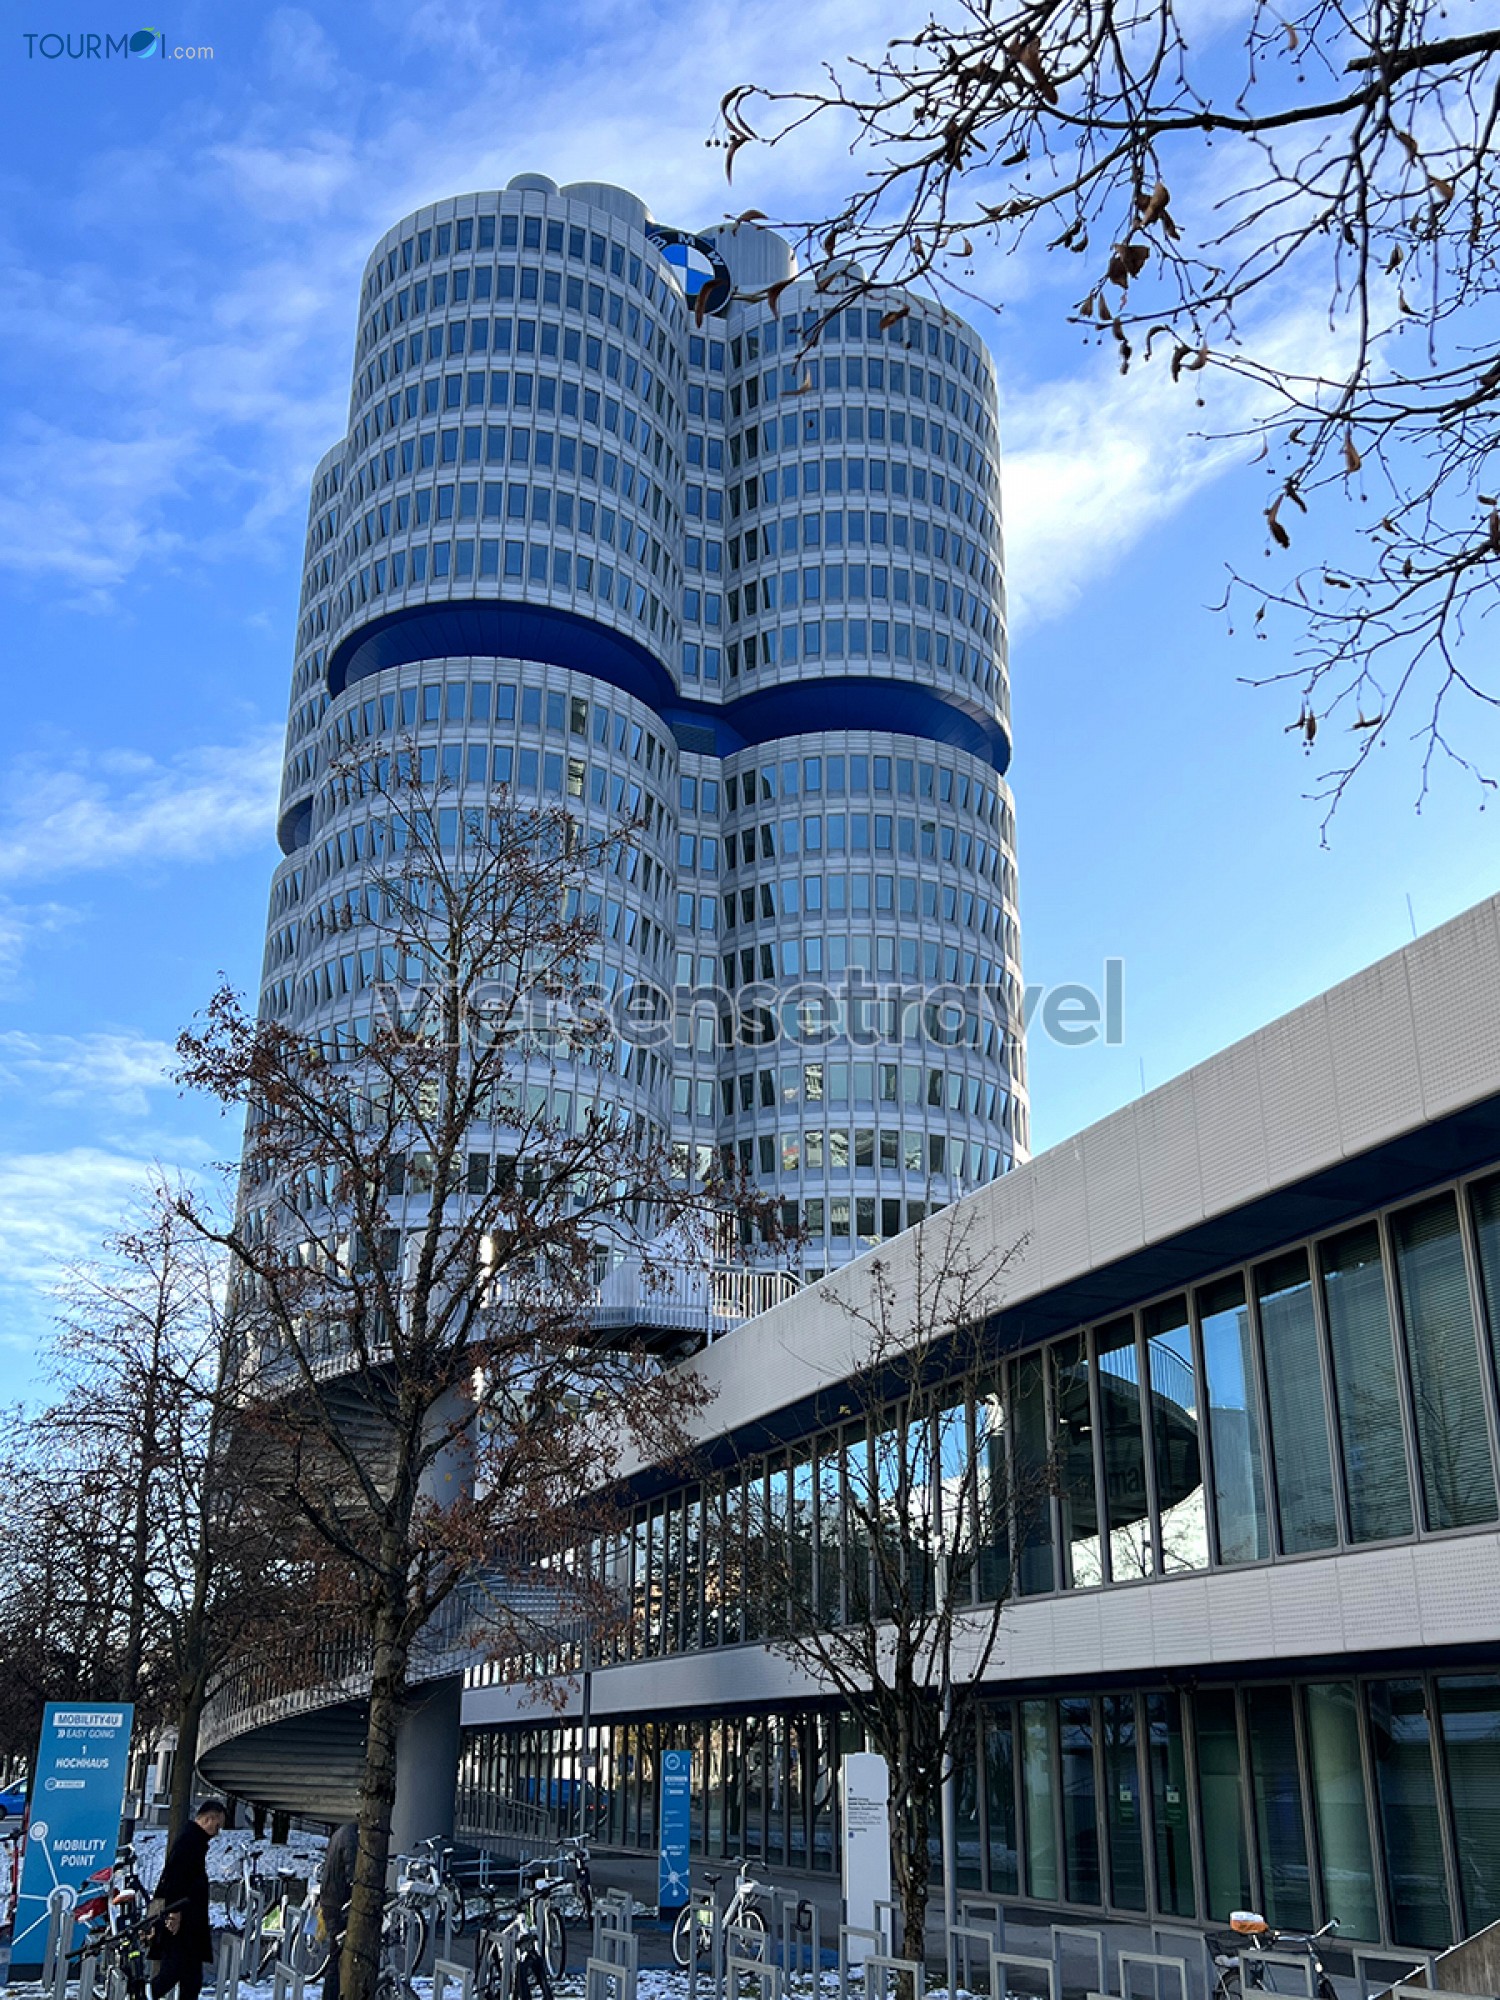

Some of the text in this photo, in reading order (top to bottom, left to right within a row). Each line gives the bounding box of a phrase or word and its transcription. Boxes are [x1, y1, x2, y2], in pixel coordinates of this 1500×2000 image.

[649, 231, 724, 266] BMW
[57, 1714, 119, 1725] MOBILITY4U
[66, 1729, 115, 1739] EASY GOING
[81, 1745, 87, 1755] 1
[55, 1758, 109, 1768] HOCHHAUS
[53, 1839, 107, 1851] MOBILITY
[60, 1855, 96, 1867] POINT
